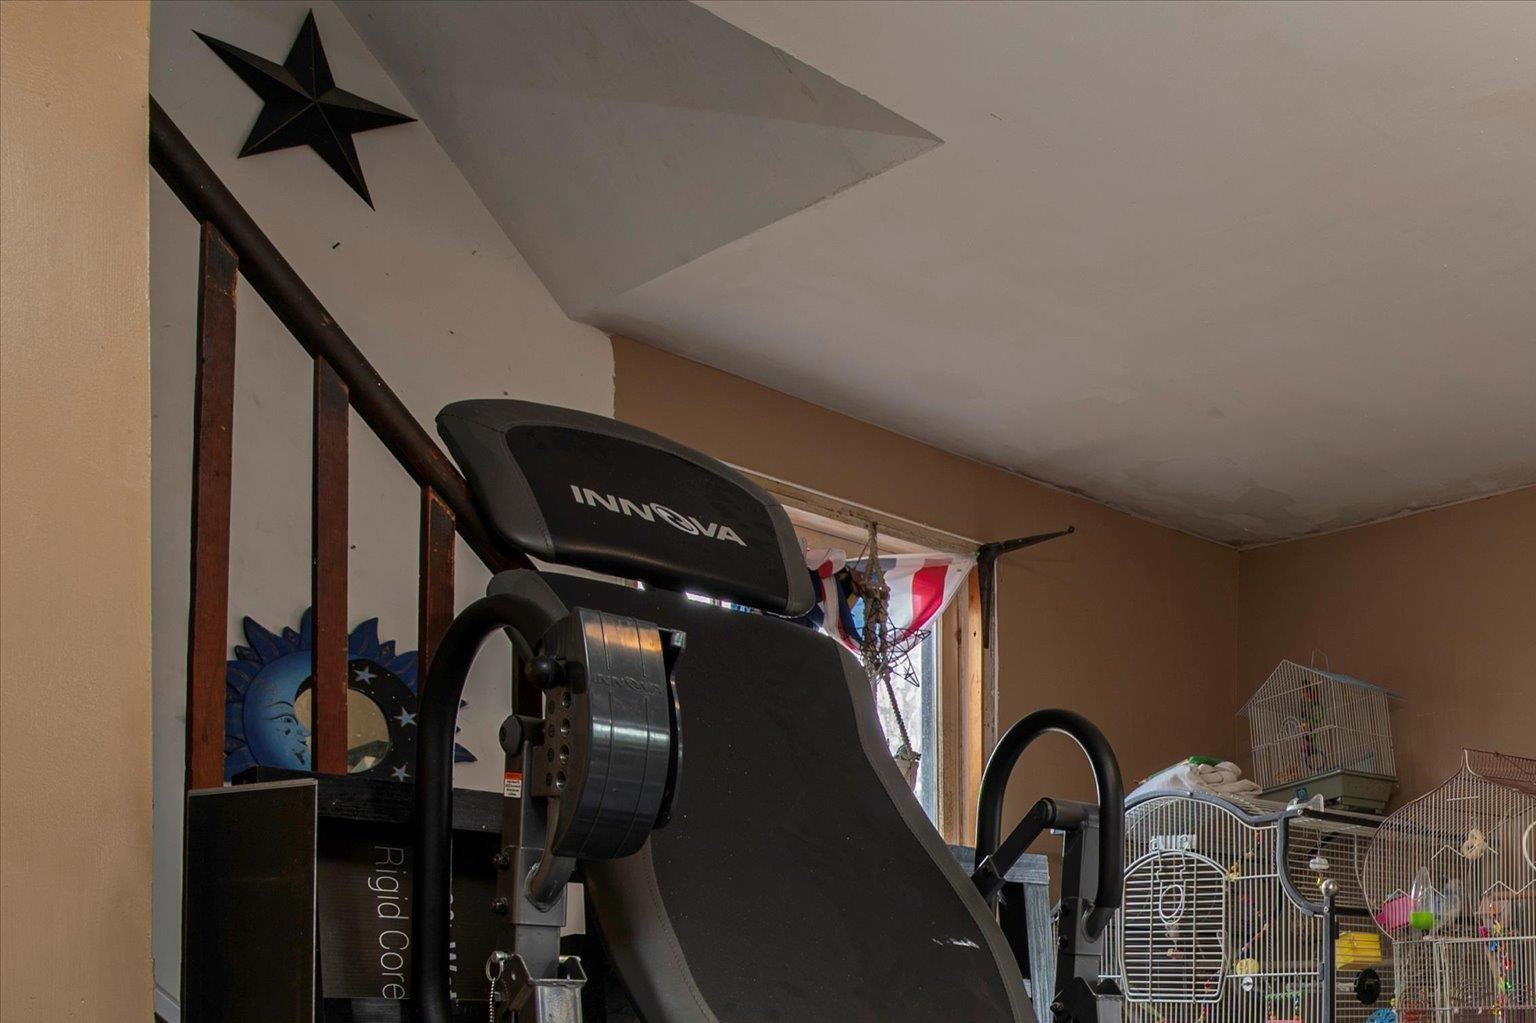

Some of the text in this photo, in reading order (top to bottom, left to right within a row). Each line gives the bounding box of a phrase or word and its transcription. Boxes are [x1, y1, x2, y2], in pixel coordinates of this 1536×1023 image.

[570, 484, 748, 547] INNOVA
[367, 846, 410, 1000] Rigid Core
